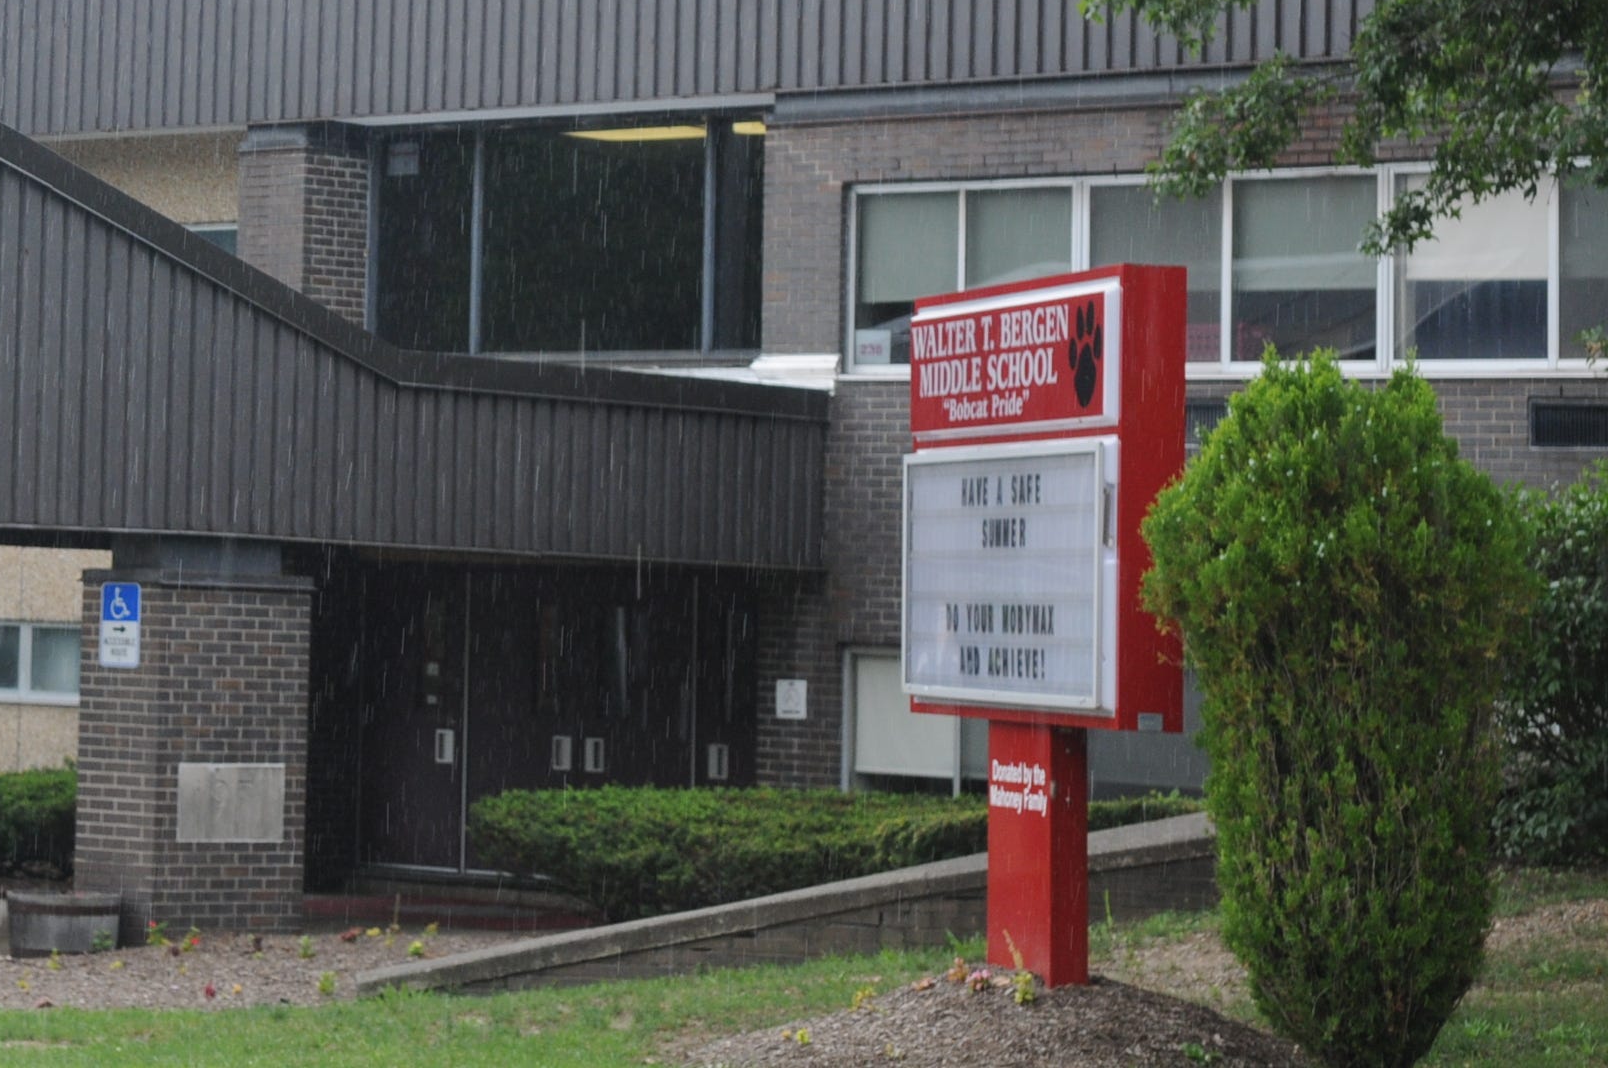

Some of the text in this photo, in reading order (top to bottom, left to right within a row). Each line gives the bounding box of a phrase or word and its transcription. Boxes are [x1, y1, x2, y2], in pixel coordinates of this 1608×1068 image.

[911, 304, 1069, 360] WALTER T. BERGEN
[919, 348, 1058, 398] MIDDLE SCHOOL
[961, 473, 1041, 507] HAVE A SAFE
[982, 517, 1026, 548] SUMMER
[946, 603, 1055, 636] DO YOUR MOBYMAX
[959, 645, 1046, 680] AND ACHIEVE!
[992, 758, 1022, 784] Donated
[1023, 761, 1033, 791] by
[1023, 786, 1048, 818] Family
